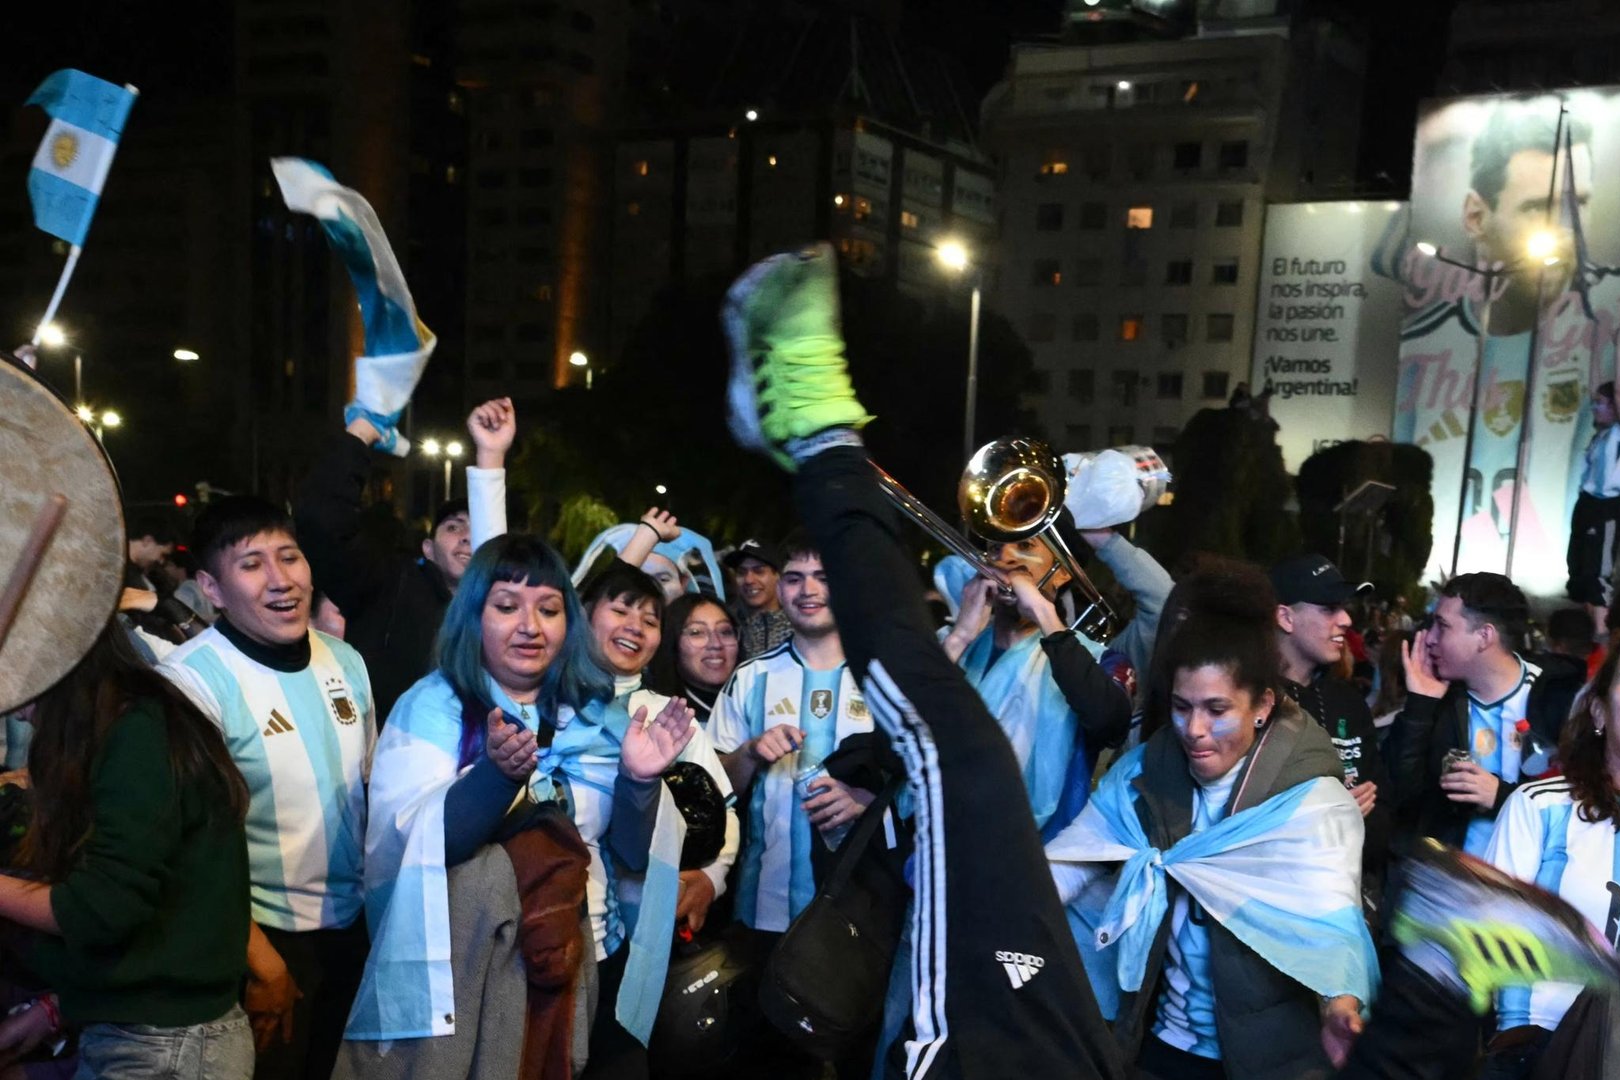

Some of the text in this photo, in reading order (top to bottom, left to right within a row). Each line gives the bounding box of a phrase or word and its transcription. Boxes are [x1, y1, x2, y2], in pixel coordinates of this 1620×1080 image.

[1273, 257, 1346, 276] El futuro
[1270, 280, 1369, 303] nos inspira,
[1268, 303, 1283, 320] la
[1266, 326, 1299, 342] nos
[1264, 355, 1332, 377] ¡Vamos
[1263, 378, 1359, 399] Argentina!
[995, 950, 1045, 968] adidas
